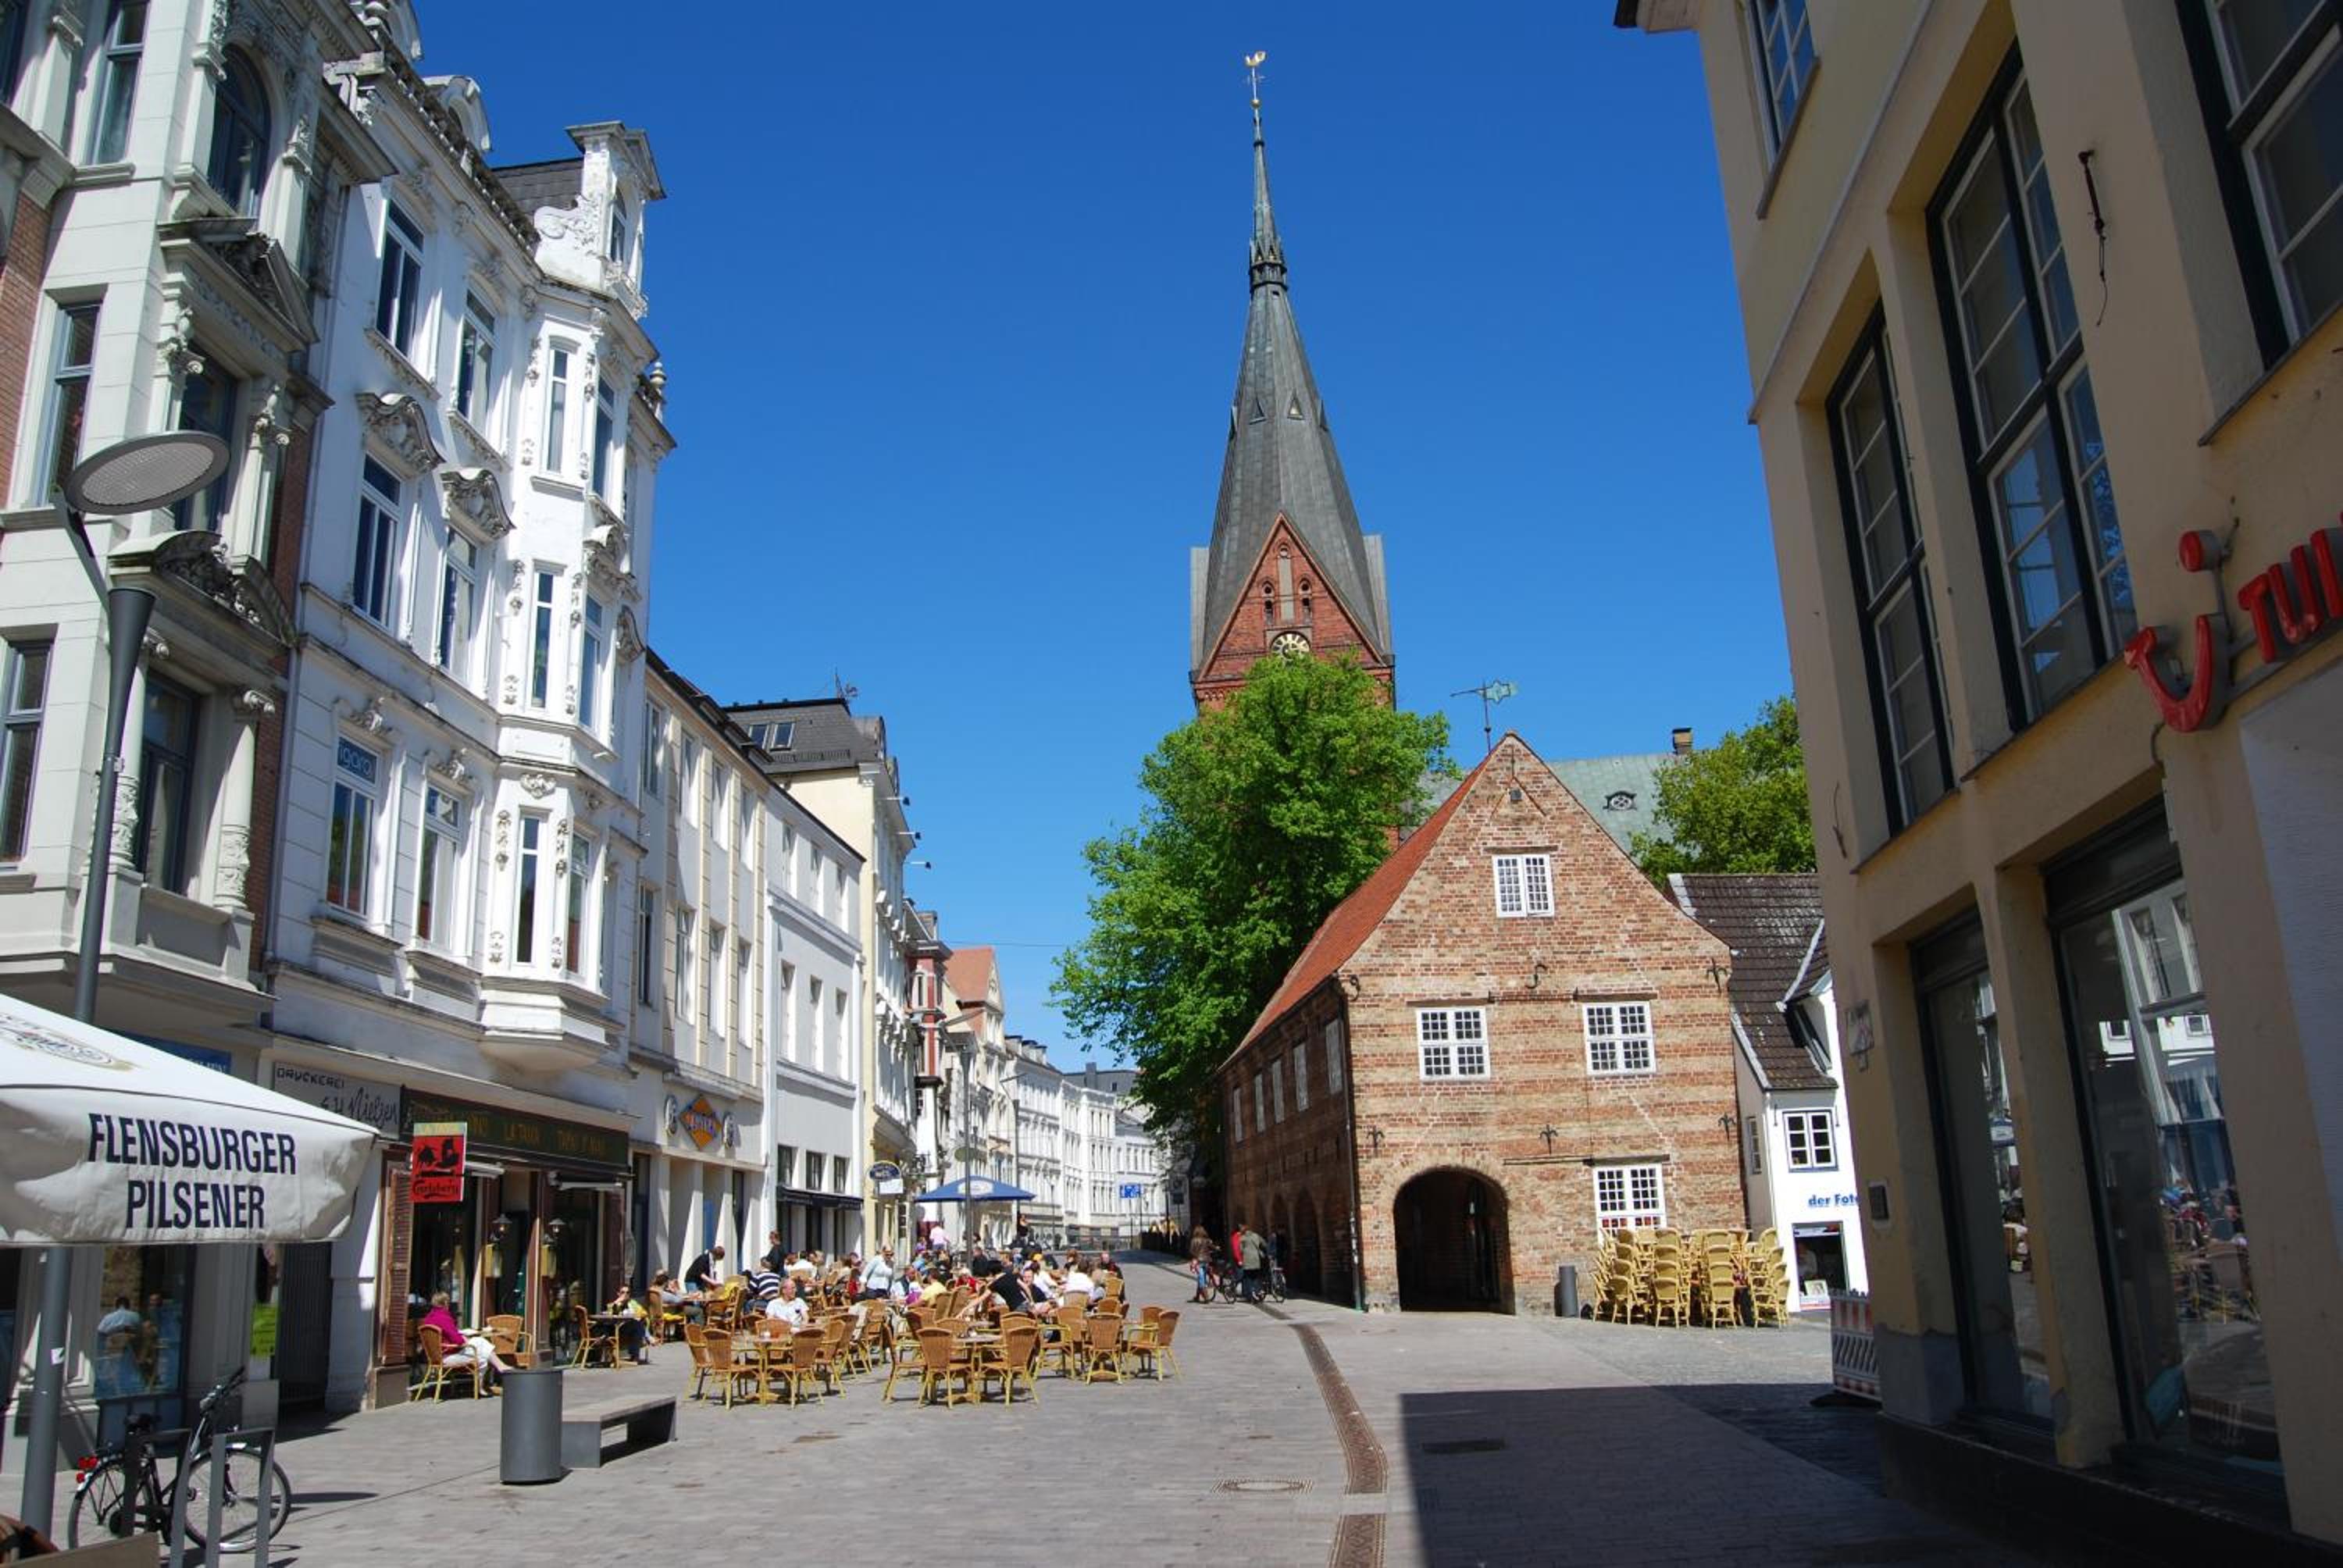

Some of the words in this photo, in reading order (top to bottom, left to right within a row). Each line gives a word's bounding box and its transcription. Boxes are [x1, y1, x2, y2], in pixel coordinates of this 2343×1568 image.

[276, 1067, 344, 1089] DRUCKEREI
[87, 1113, 296, 1174] FLENSBURGER
[126, 1180, 265, 1229] PILSENER
[1808, 1193, 1831, 1206] der
